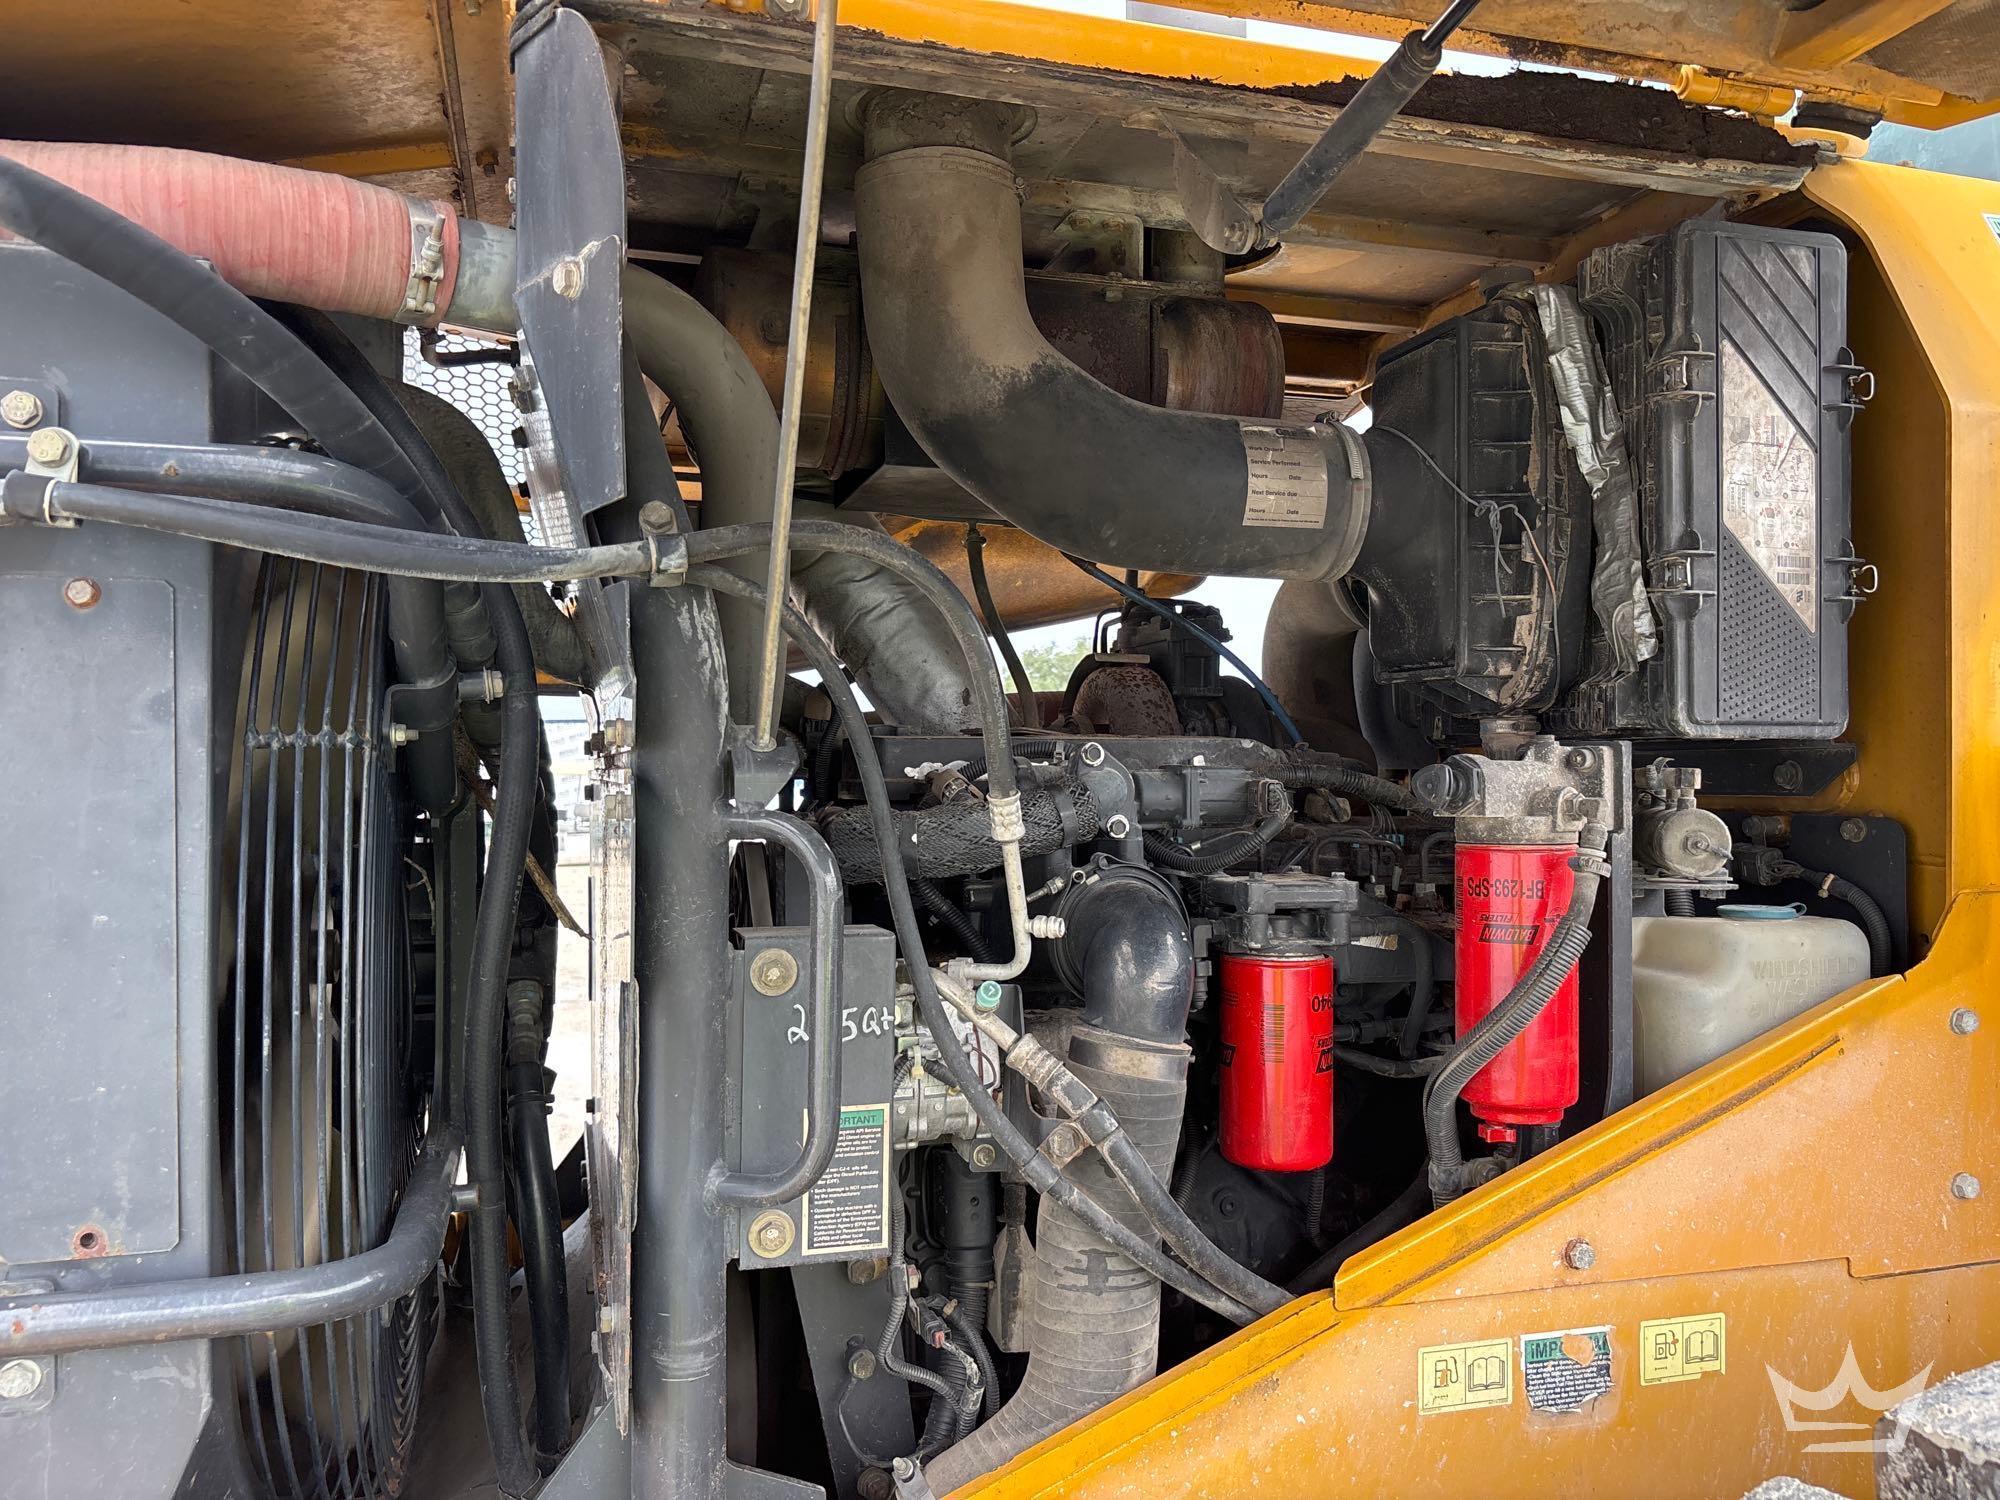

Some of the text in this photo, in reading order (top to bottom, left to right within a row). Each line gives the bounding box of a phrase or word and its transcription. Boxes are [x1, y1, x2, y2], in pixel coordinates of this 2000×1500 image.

[1467, 876, 1545, 900] BF1293-SPS
[1480, 912, 1514, 924] FILTERS
[1483, 926, 1536, 942] BALDWIN
[1751, 957, 1857, 979] WINDSHIELD
[840, 1115, 877, 1125] ORTANT
